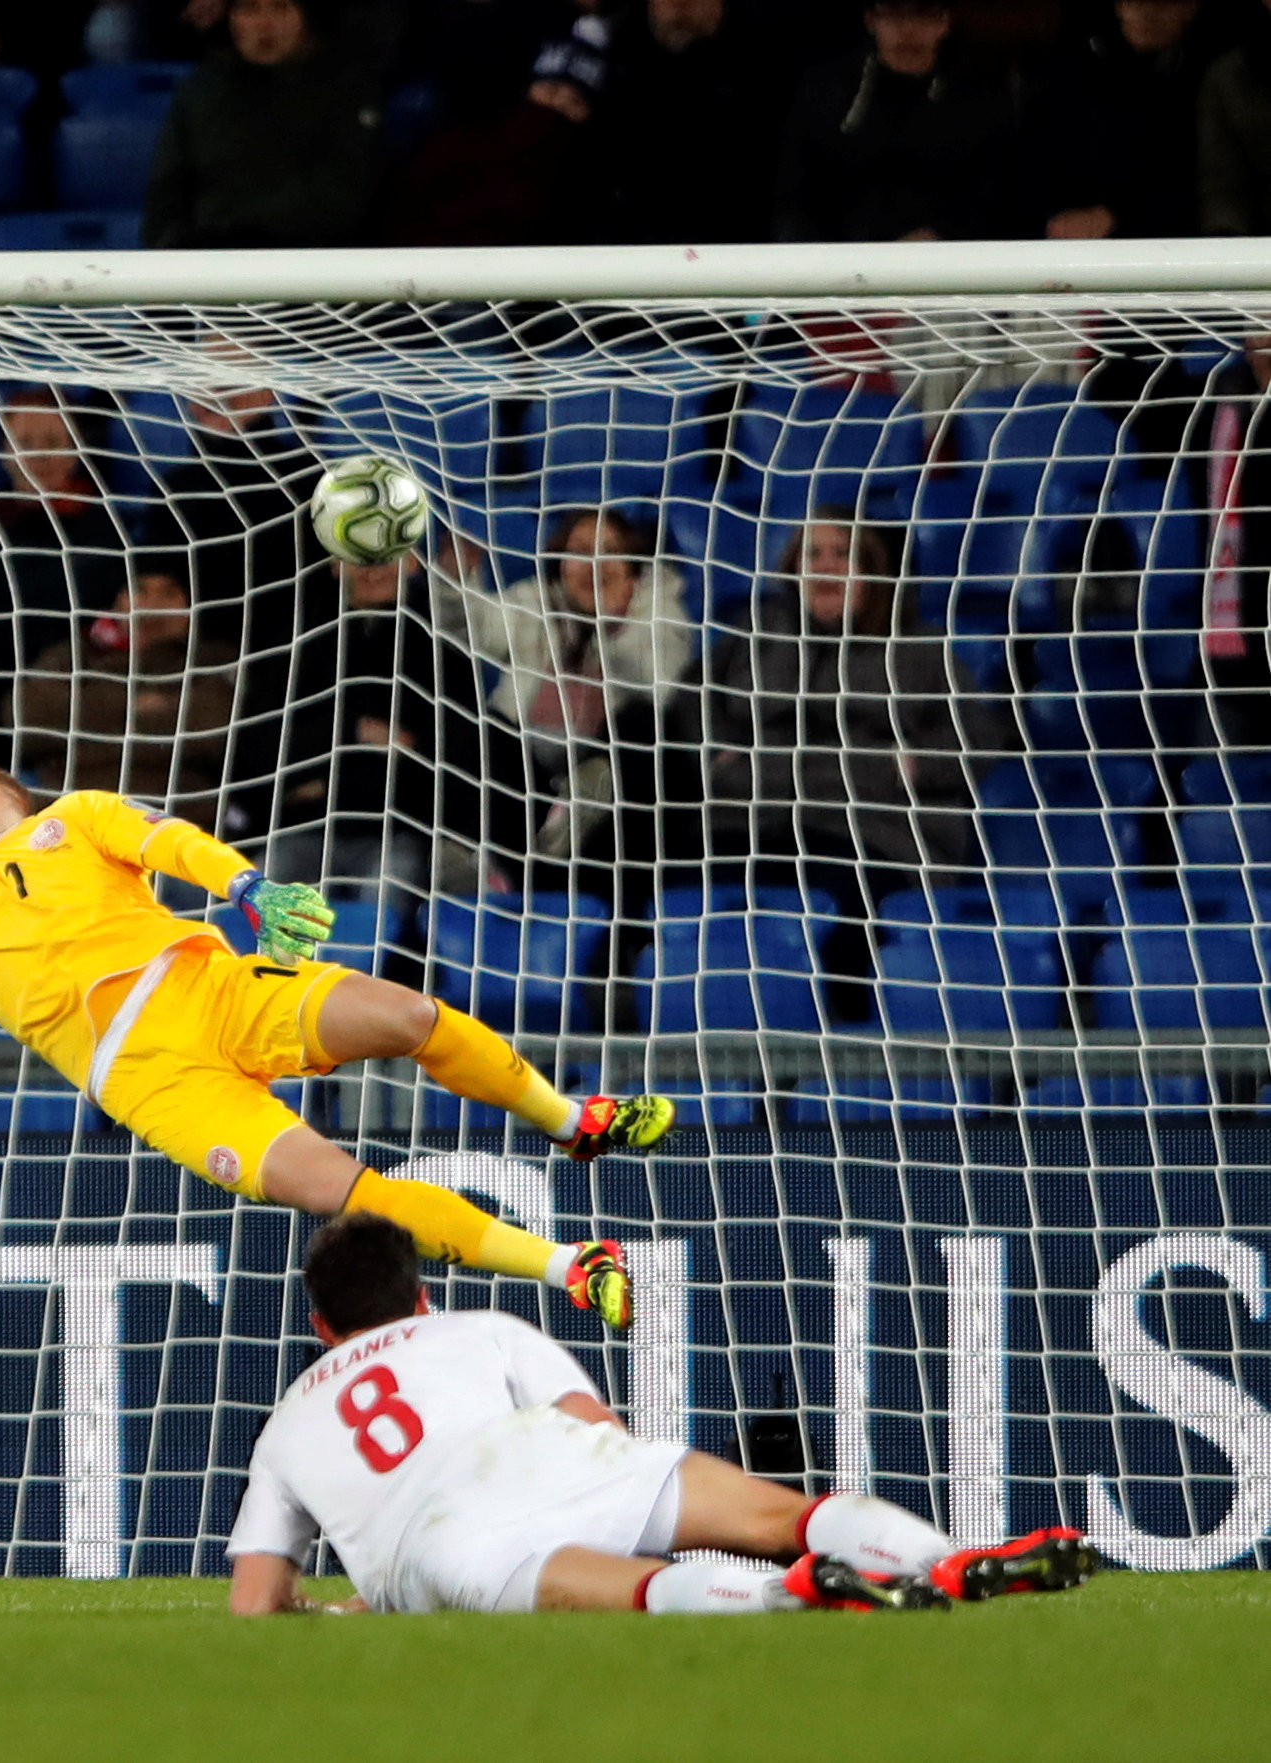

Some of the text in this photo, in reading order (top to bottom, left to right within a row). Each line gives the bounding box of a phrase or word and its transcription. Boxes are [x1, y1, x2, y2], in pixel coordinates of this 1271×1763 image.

[4, 862, 28, 899] 1
[252, 965, 299, 979] 1
[302, 1324, 419, 1396] DELANEY
[335, 1364, 424, 1474] 8
